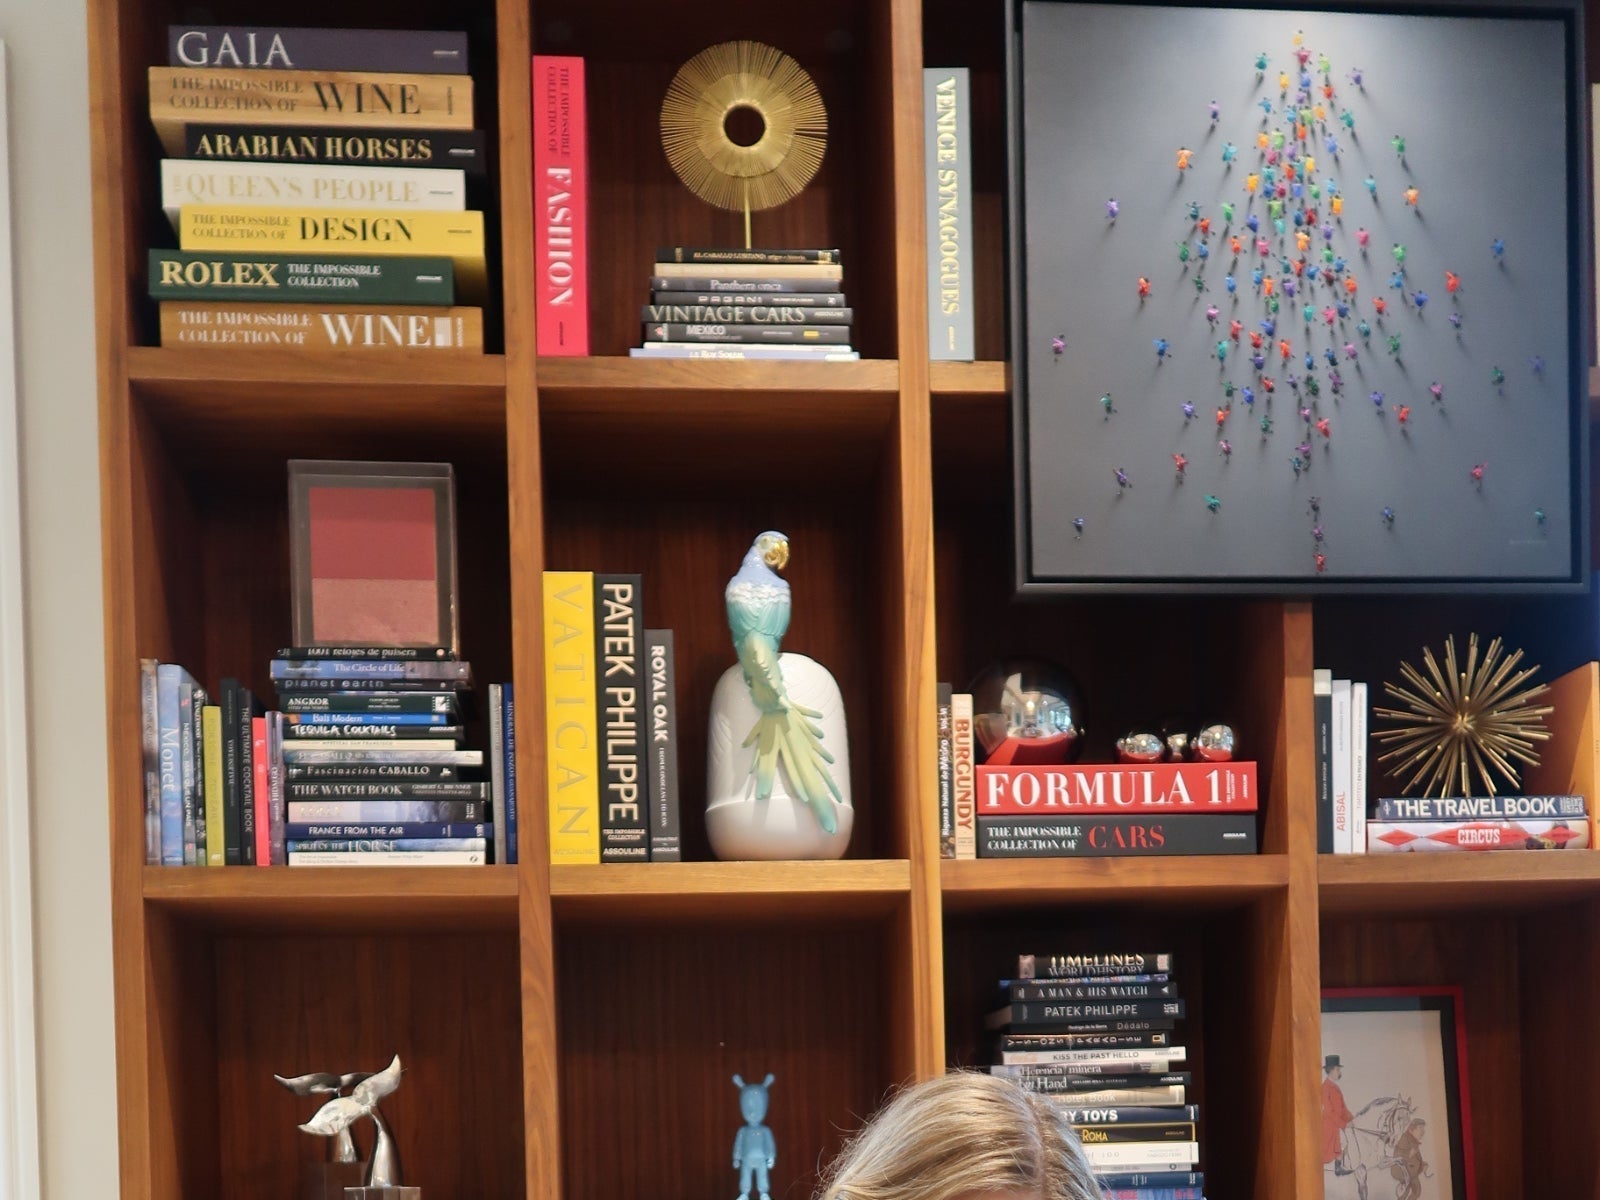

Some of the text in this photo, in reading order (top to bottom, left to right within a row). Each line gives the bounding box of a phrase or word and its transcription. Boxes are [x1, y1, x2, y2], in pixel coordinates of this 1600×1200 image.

[176, 31, 294, 66] GAIA
[171, 77, 304, 95] THE IMPOSSIBLE
[169, 96, 299, 112] COLLECTION OF
[313, 81, 421, 115] WINE
[195, 133, 432, 161] ARABIAN HORSES
[313, 177, 420, 203] PEOPLE
[936, 76, 960, 316] VENICE SYNAGOGUES
[192, 213, 290, 227] THE IMPOSSIBLE
[192, 227, 288, 240] COLLECTION OF
[299, 216, 413, 242] DESIGN
[547, 167, 574, 307] FASHION
[160, 260, 281, 287] ROLEX
[287, 263, 381, 276] THE IMPOSSIBLE
[287, 275, 360, 288] COLLECTION
[709, 280, 757, 291] Panthera
[178, 311, 313, 327] THE IMPOSSIBLE
[650, 305, 806, 322] VINTAGE CARS
[178, 329, 307, 345] COLLECTION OF
[318, 313, 432, 347] WINE
[686, 325, 726, 336] MEXICO
[333, 663, 405, 672] The Circle of Life
[284, 679, 336, 688] planet
[287, 697, 329, 706] ANGKOR
[650, 645, 668, 742] ROYAL OAK
[552, 584, 591, 837] VATICAN
[602, 583, 639, 822] PATEK PHILIPPE
[312, 714, 330, 722] Bali
[331, 714, 363, 723] Modern
[507, 700, 515, 737] MINERAL
[290, 724, 397, 737] TEQUILA COCKTAILS
[508, 739, 515, 750] DE
[161, 727, 179, 792] Monet
[508, 751, 516, 777] POZOS
[241, 707, 252, 832] THE ULTIMATE COCKTAIL BOOK
[306, 766, 430, 775] Fascinación CABALLO
[955, 719, 972, 830] BURGUNDY
[292, 784, 318, 795] THE
[321, 784, 365, 795] WATCH
[368, 784, 403, 795] BOOK
[985, 770, 1195, 807] FORMULA
[1206, 769, 1222, 805] 1
[1336, 791, 1346, 832] ABISAL
[1393, 799, 1432, 817] THE
[1437, 798, 1504, 817] TRAVEL
[1504, 797, 1557, 815] BOOK
[308, 826, 404, 835] FRANCE FROM THE AIR
[986, 826, 1082, 837] THE IMPOSSIBLE
[1088, 825, 1166, 849] CARS
[1457, 829, 1501, 845] CIRCUS
[603, 847, 646, 855] ASSOULINE
[986, 839, 1078, 850] COLLECTION OF
[1037, 986, 1148, 998] A MAN & HIS WATCH
[1044, 1004, 1138, 1016] PATEK PHILIPPE
[1007, 1035, 1142, 1046] VISIONS PARADISE
[1090, 1052, 1111, 1060] PAST
[1113, 1051, 1139, 1059] HELLO
[1068, 1066, 1102, 1074] minera
[1036, 1077, 1068, 1089] Hand
[1082, 1109, 1118, 1121] TOYS
[1082, 1128, 1108, 1141] ROMA
